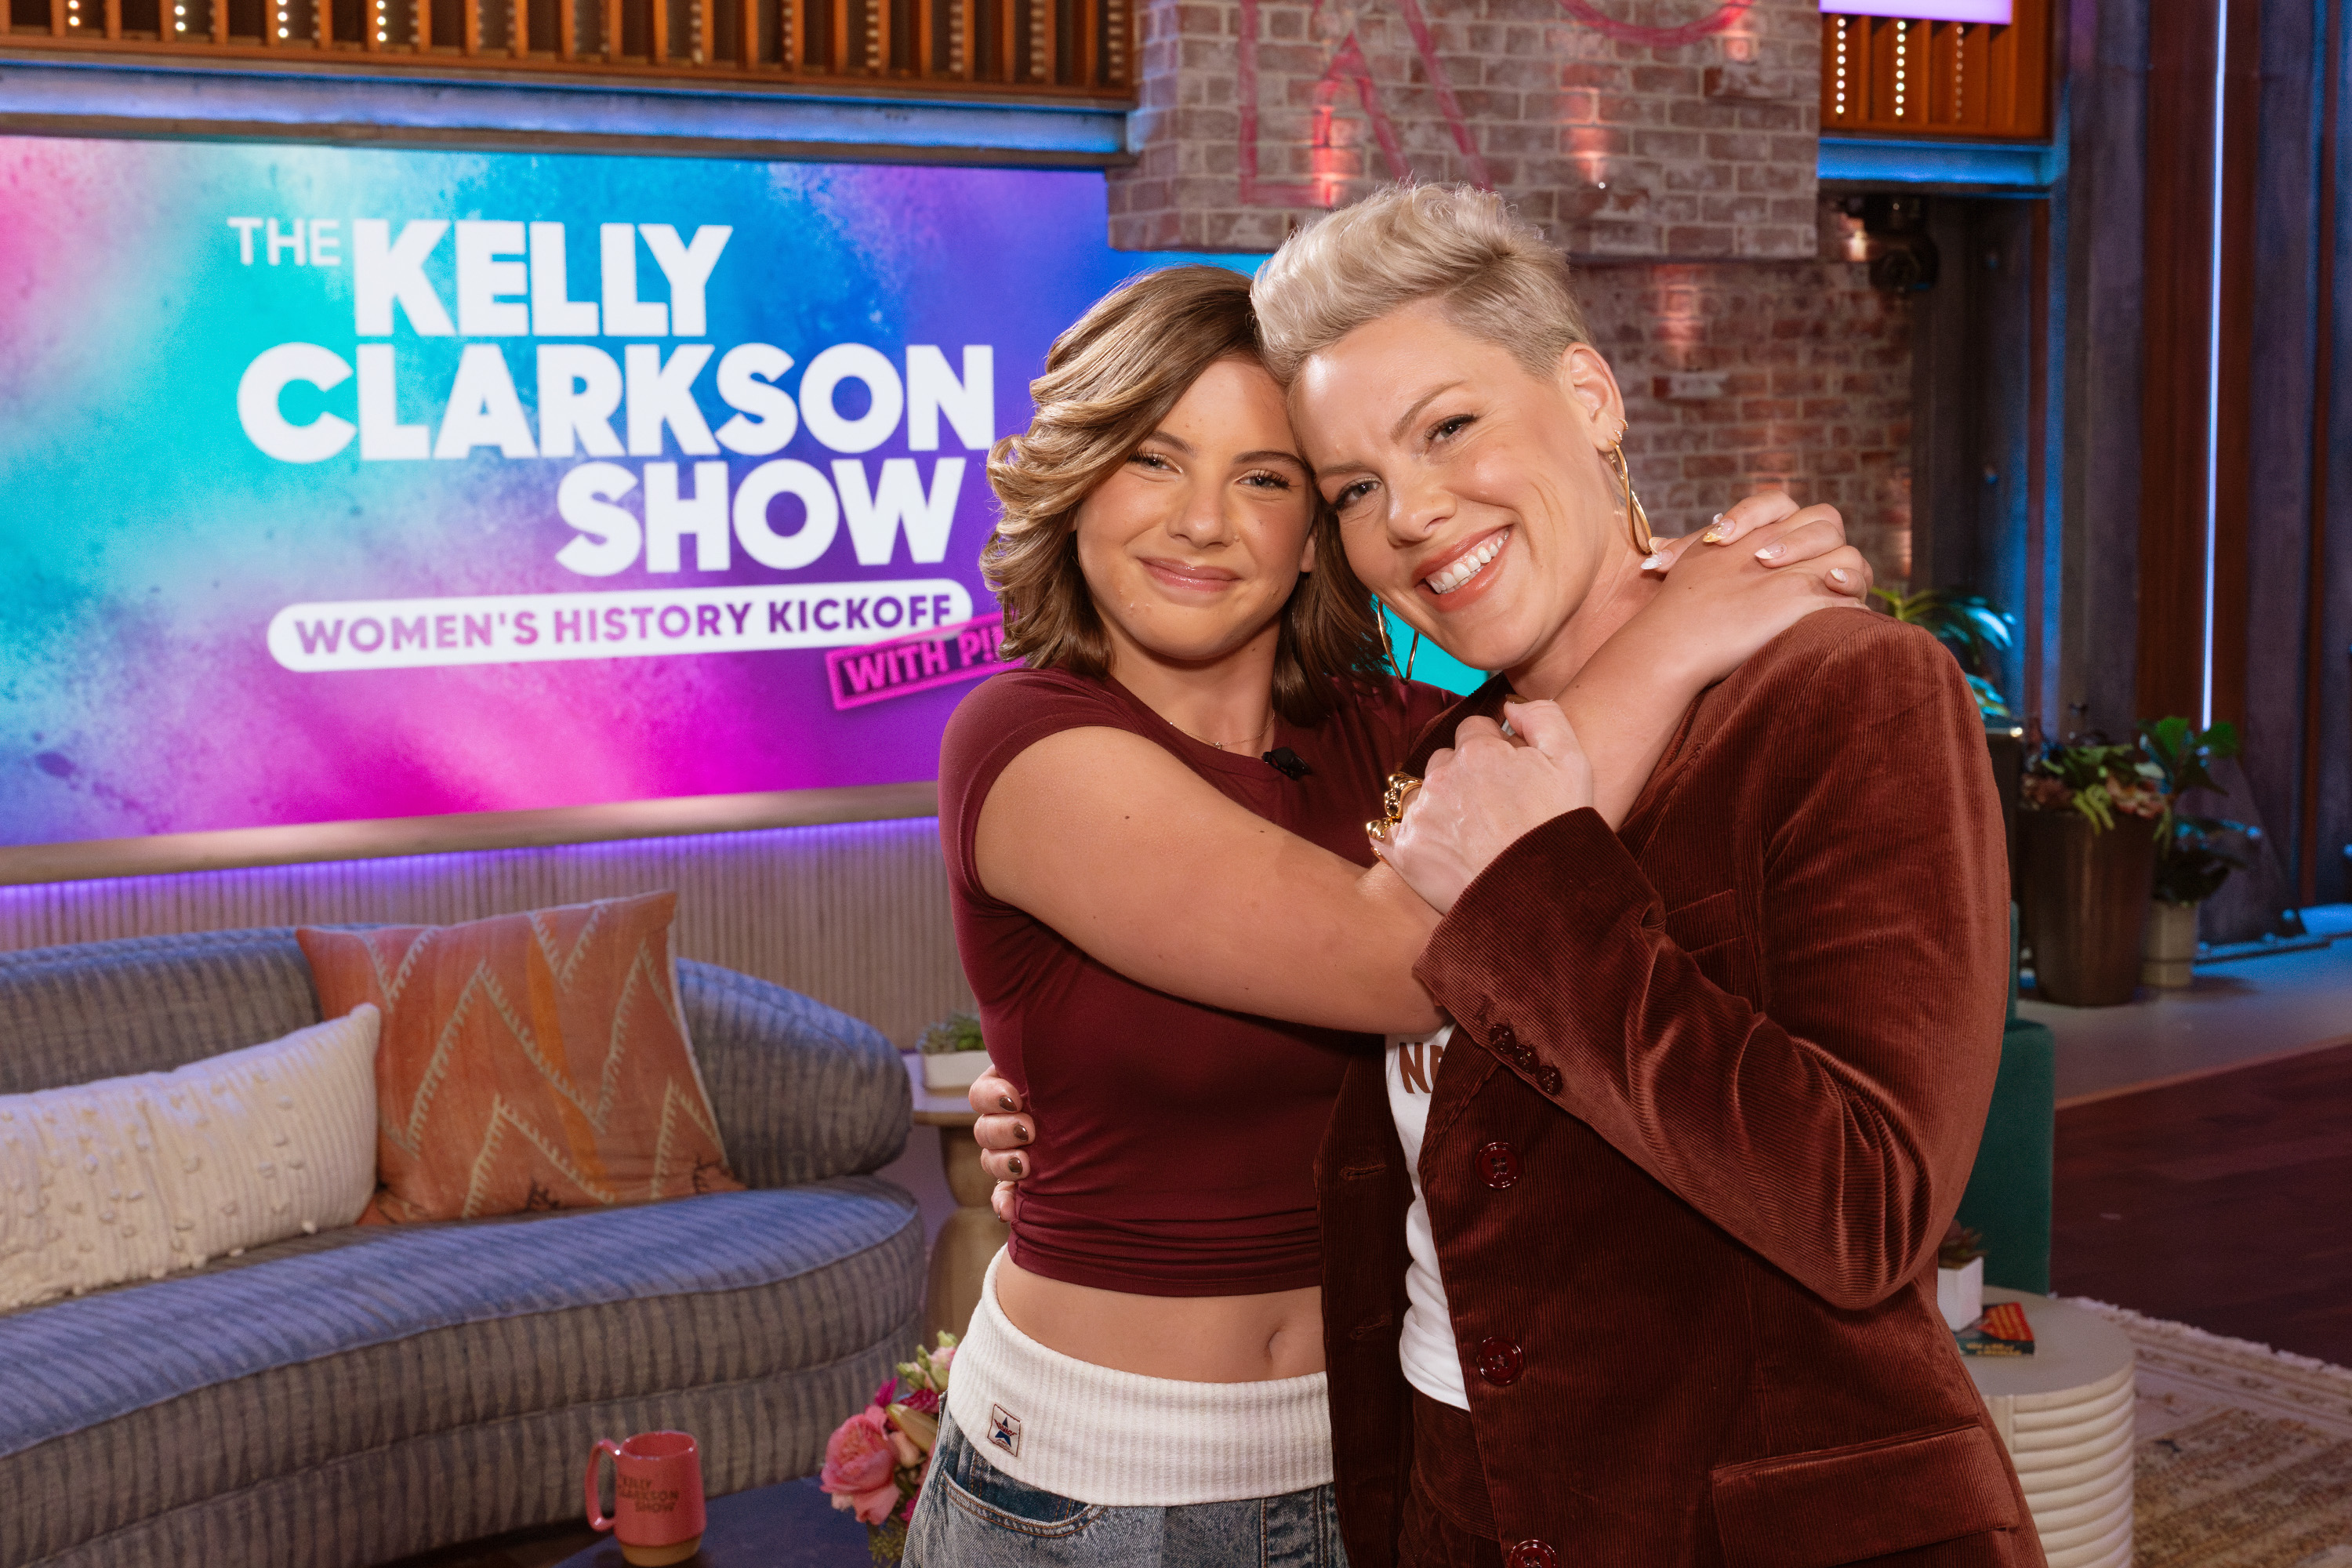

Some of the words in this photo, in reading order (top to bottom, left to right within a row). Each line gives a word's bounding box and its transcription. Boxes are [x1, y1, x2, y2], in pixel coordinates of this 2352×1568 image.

[226, 216, 341, 267] THE
[352, 217, 734, 337] KELLY
[236, 341, 996, 464] CLARKSON
[554, 456, 967, 577] SHOW
[294, 610, 539, 655] WOMEN'S
[554, 602, 753, 644] HISTORY
[768, 593, 952, 633] KICKOFF
[844, 639, 950, 693] WITH
